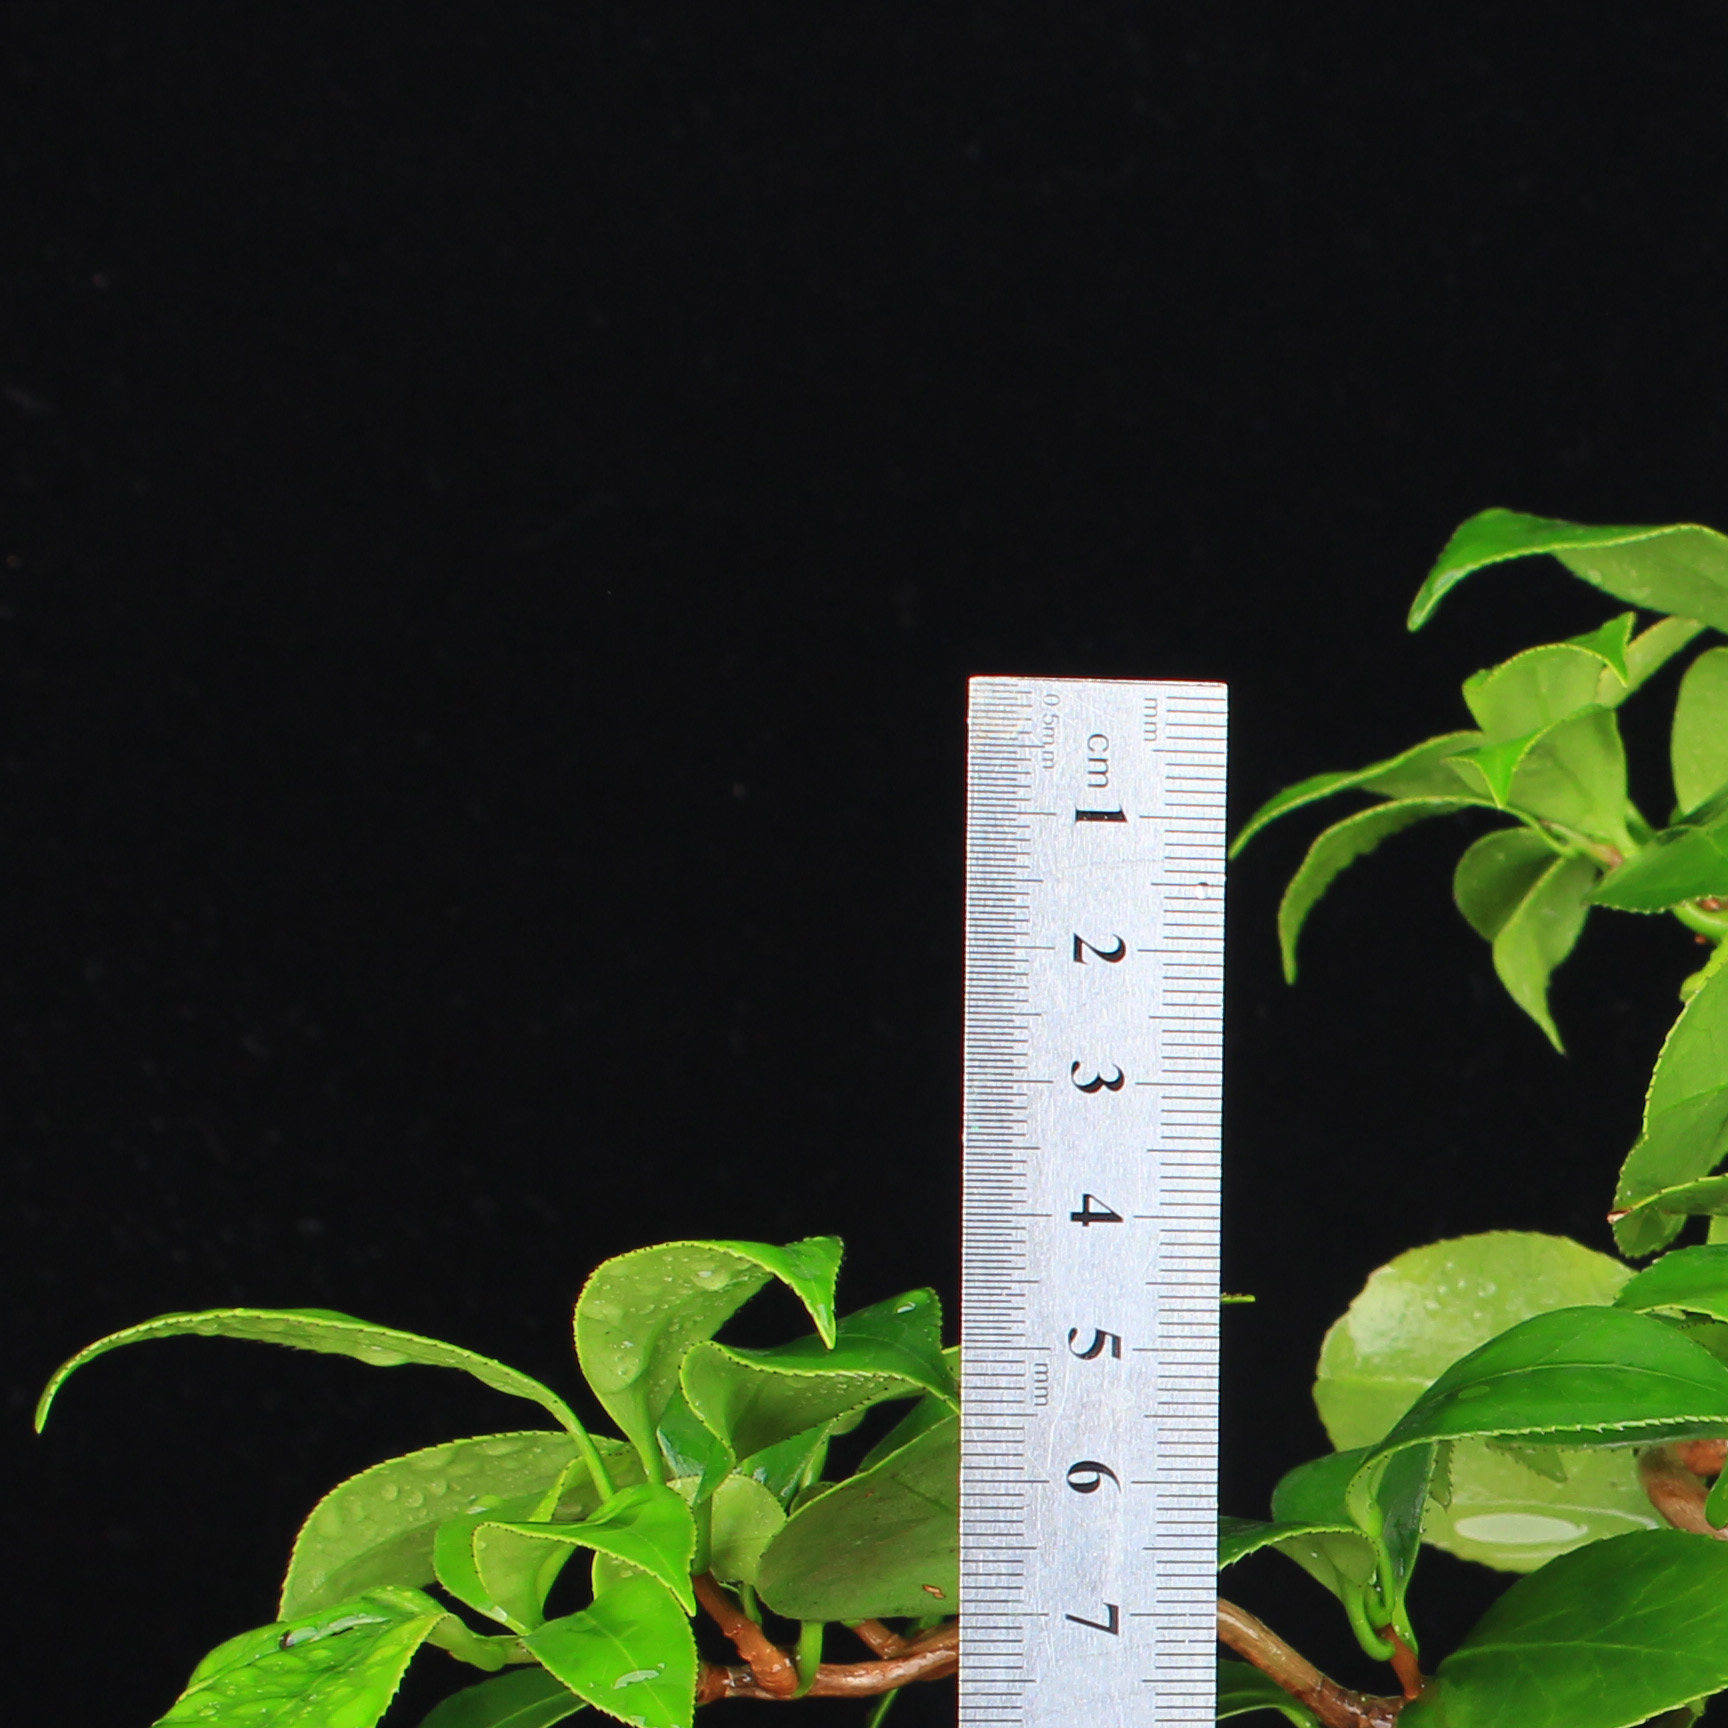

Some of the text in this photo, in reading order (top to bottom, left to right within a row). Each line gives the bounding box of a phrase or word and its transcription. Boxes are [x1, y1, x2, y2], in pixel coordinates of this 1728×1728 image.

[1143, 697, 1159, 742] mm
[1086, 733, 1110, 789] cm
[1074, 807, 1128, 824] 1
[1072, 932, 1127, 965] 2
[1070, 1060, 1126, 1095] 3
[1069, 1193, 1124, 1228] 4
[1067, 1327, 1122, 1361] 5
[1033, 1362, 1049, 1407] mm
[1066, 1460, 1120, 1495] 6
[1065, 1602, 1119, 1636] 7
